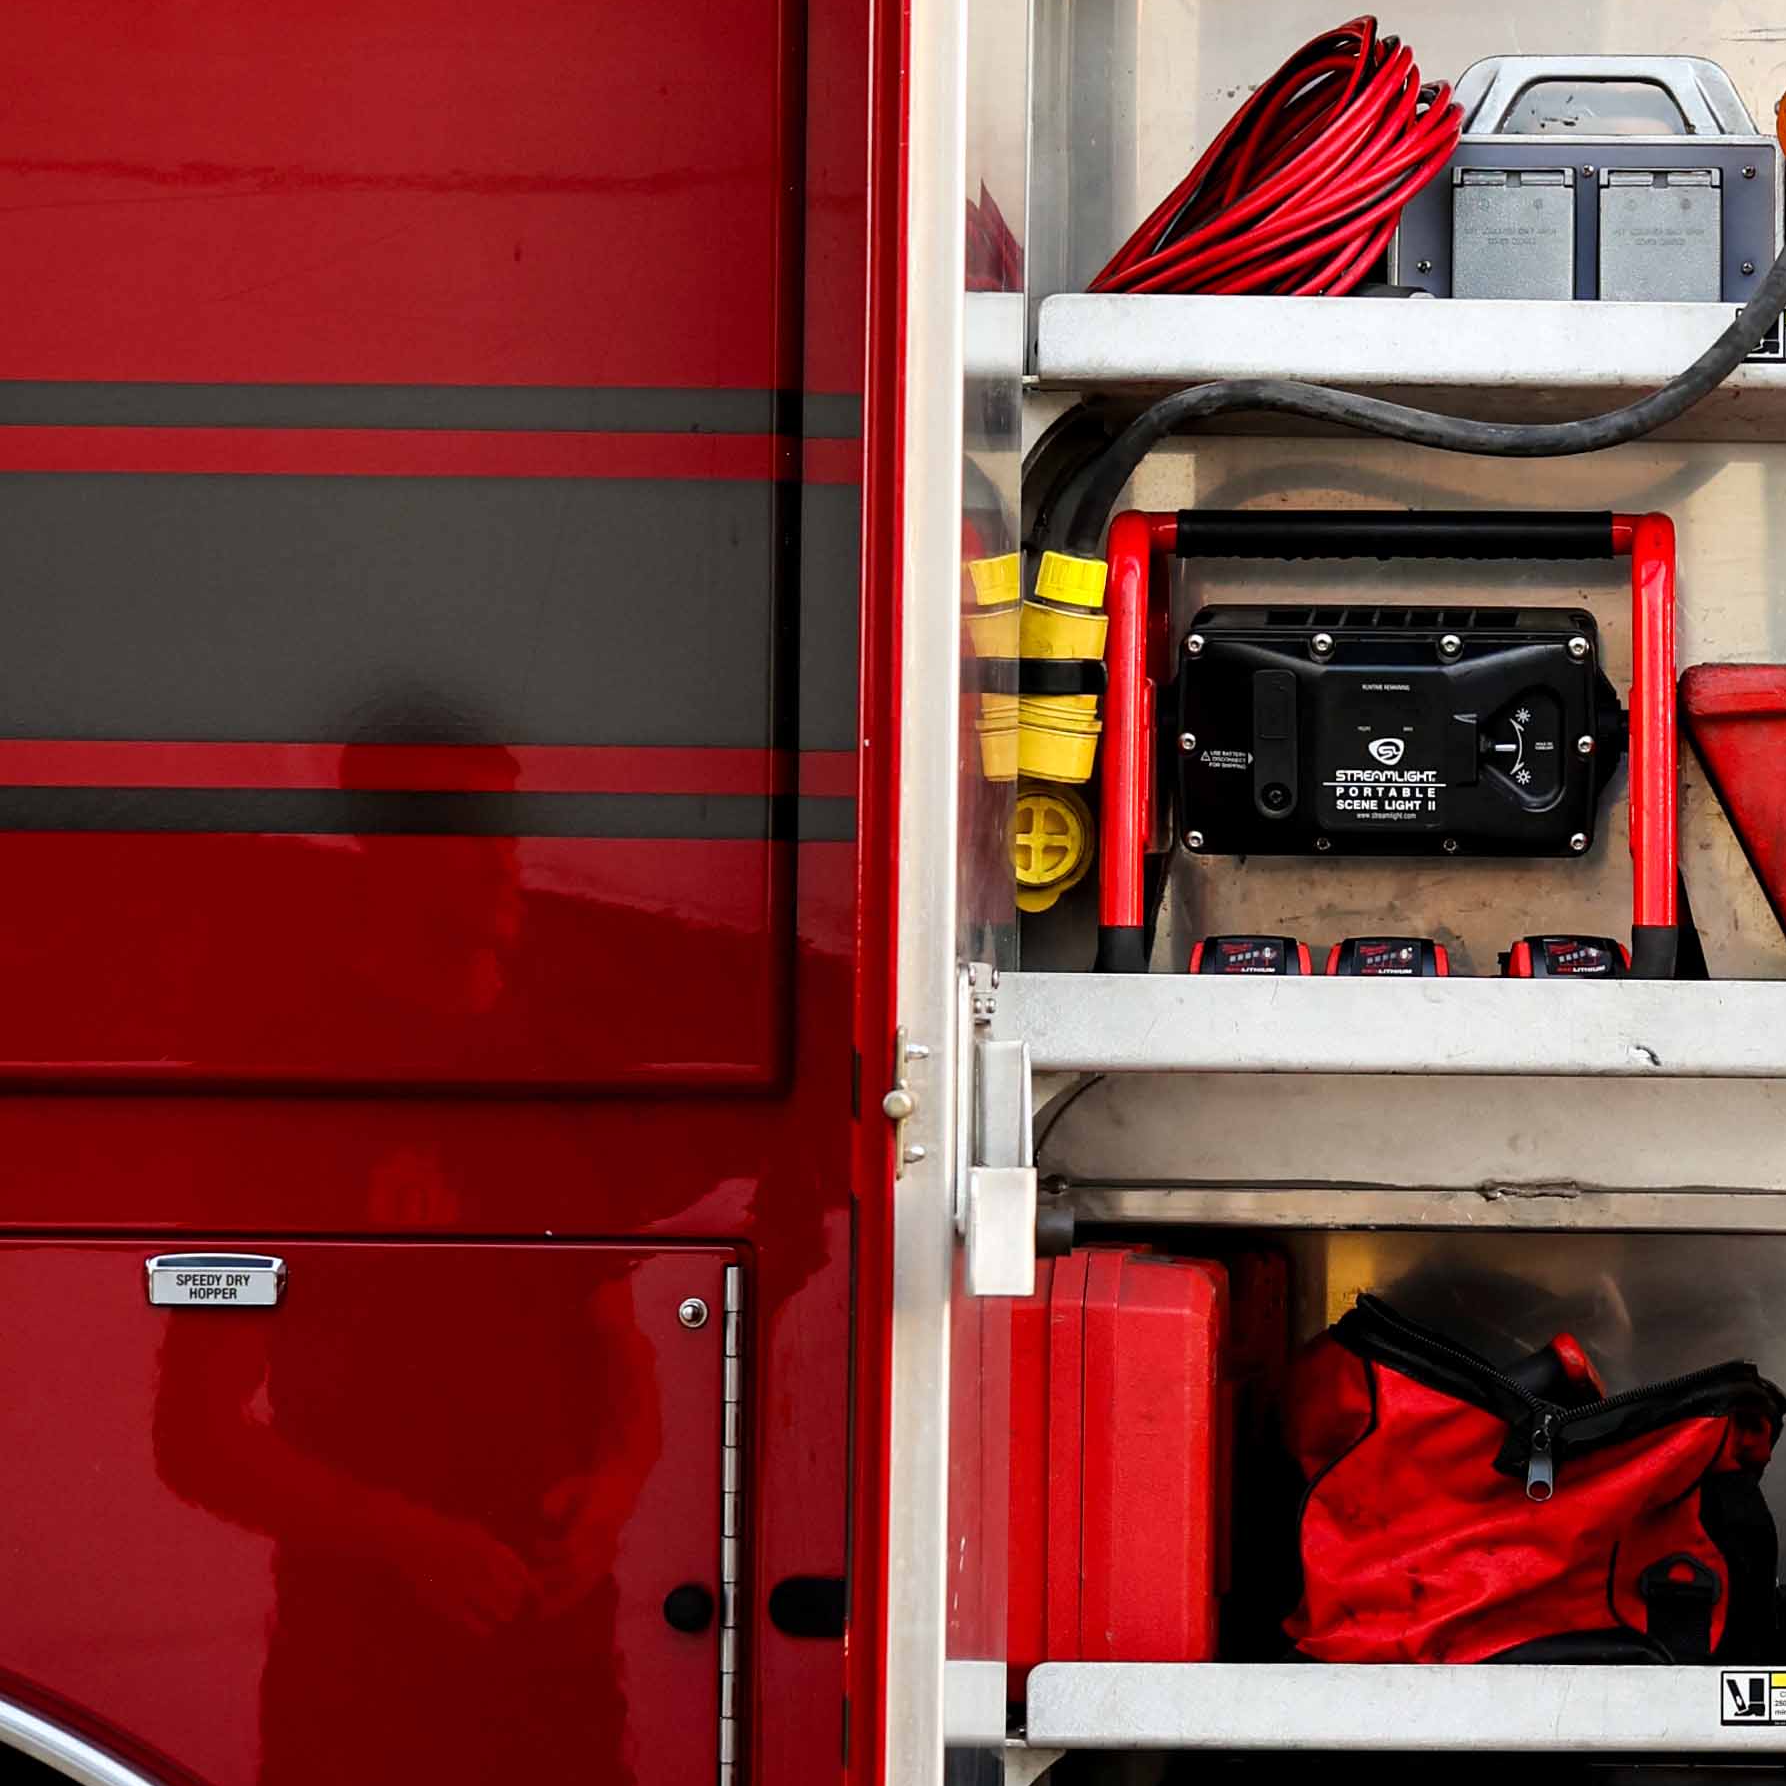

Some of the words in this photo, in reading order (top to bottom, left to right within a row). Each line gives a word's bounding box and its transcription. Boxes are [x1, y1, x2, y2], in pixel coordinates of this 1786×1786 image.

[1336, 770, 1437, 782] STREAMLIGHT
[1336, 786, 1436, 798] PORTABLE
[1336, 799, 1378, 810] SCENE
[1384, 800, 1421, 810] LIGHT
[1428, 801, 1436, 811] II
[1357, 813, 1416, 821] www.streamlight.com
[176, 1274, 223, 1286] SPEEDY
[226, 1274, 250, 1286] DRY
[189, 1288, 237, 1300] HOPPER
